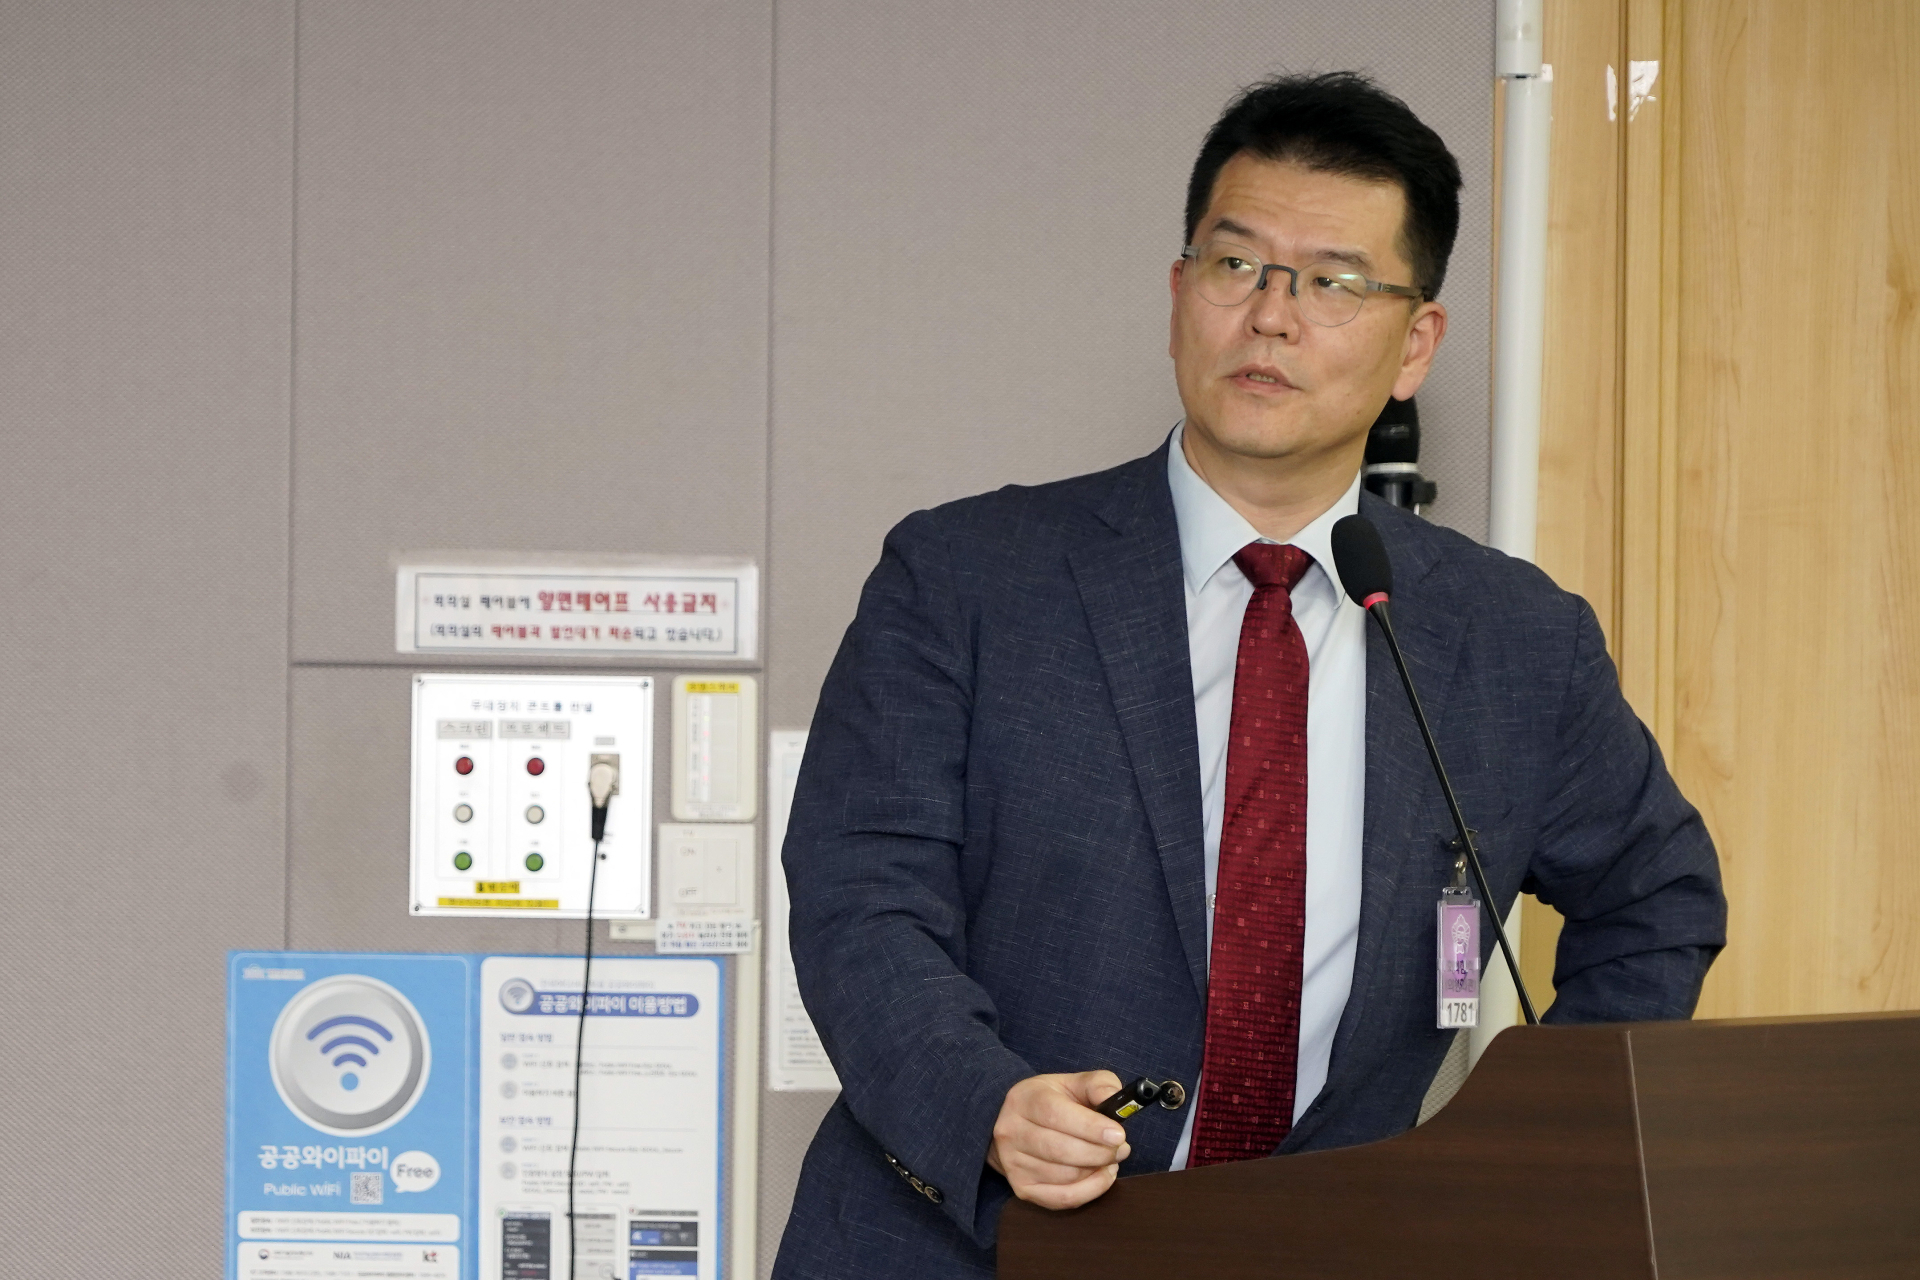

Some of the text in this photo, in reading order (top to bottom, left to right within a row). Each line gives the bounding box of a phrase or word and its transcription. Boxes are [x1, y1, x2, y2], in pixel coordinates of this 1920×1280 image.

[537, 590, 629, 613] 양면테이프
[643, 591, 717, 614] 사용금지
[538, 994, 688, 1015] 공공와이파이 이용방법
[1446, 1002, 1474, 1024] 1781
[257, 1145, 389, 1170] 공공와이파이
[396, 1163, 434, 1179] Free
[263, 1182, 342, 1197] Public WiFi
